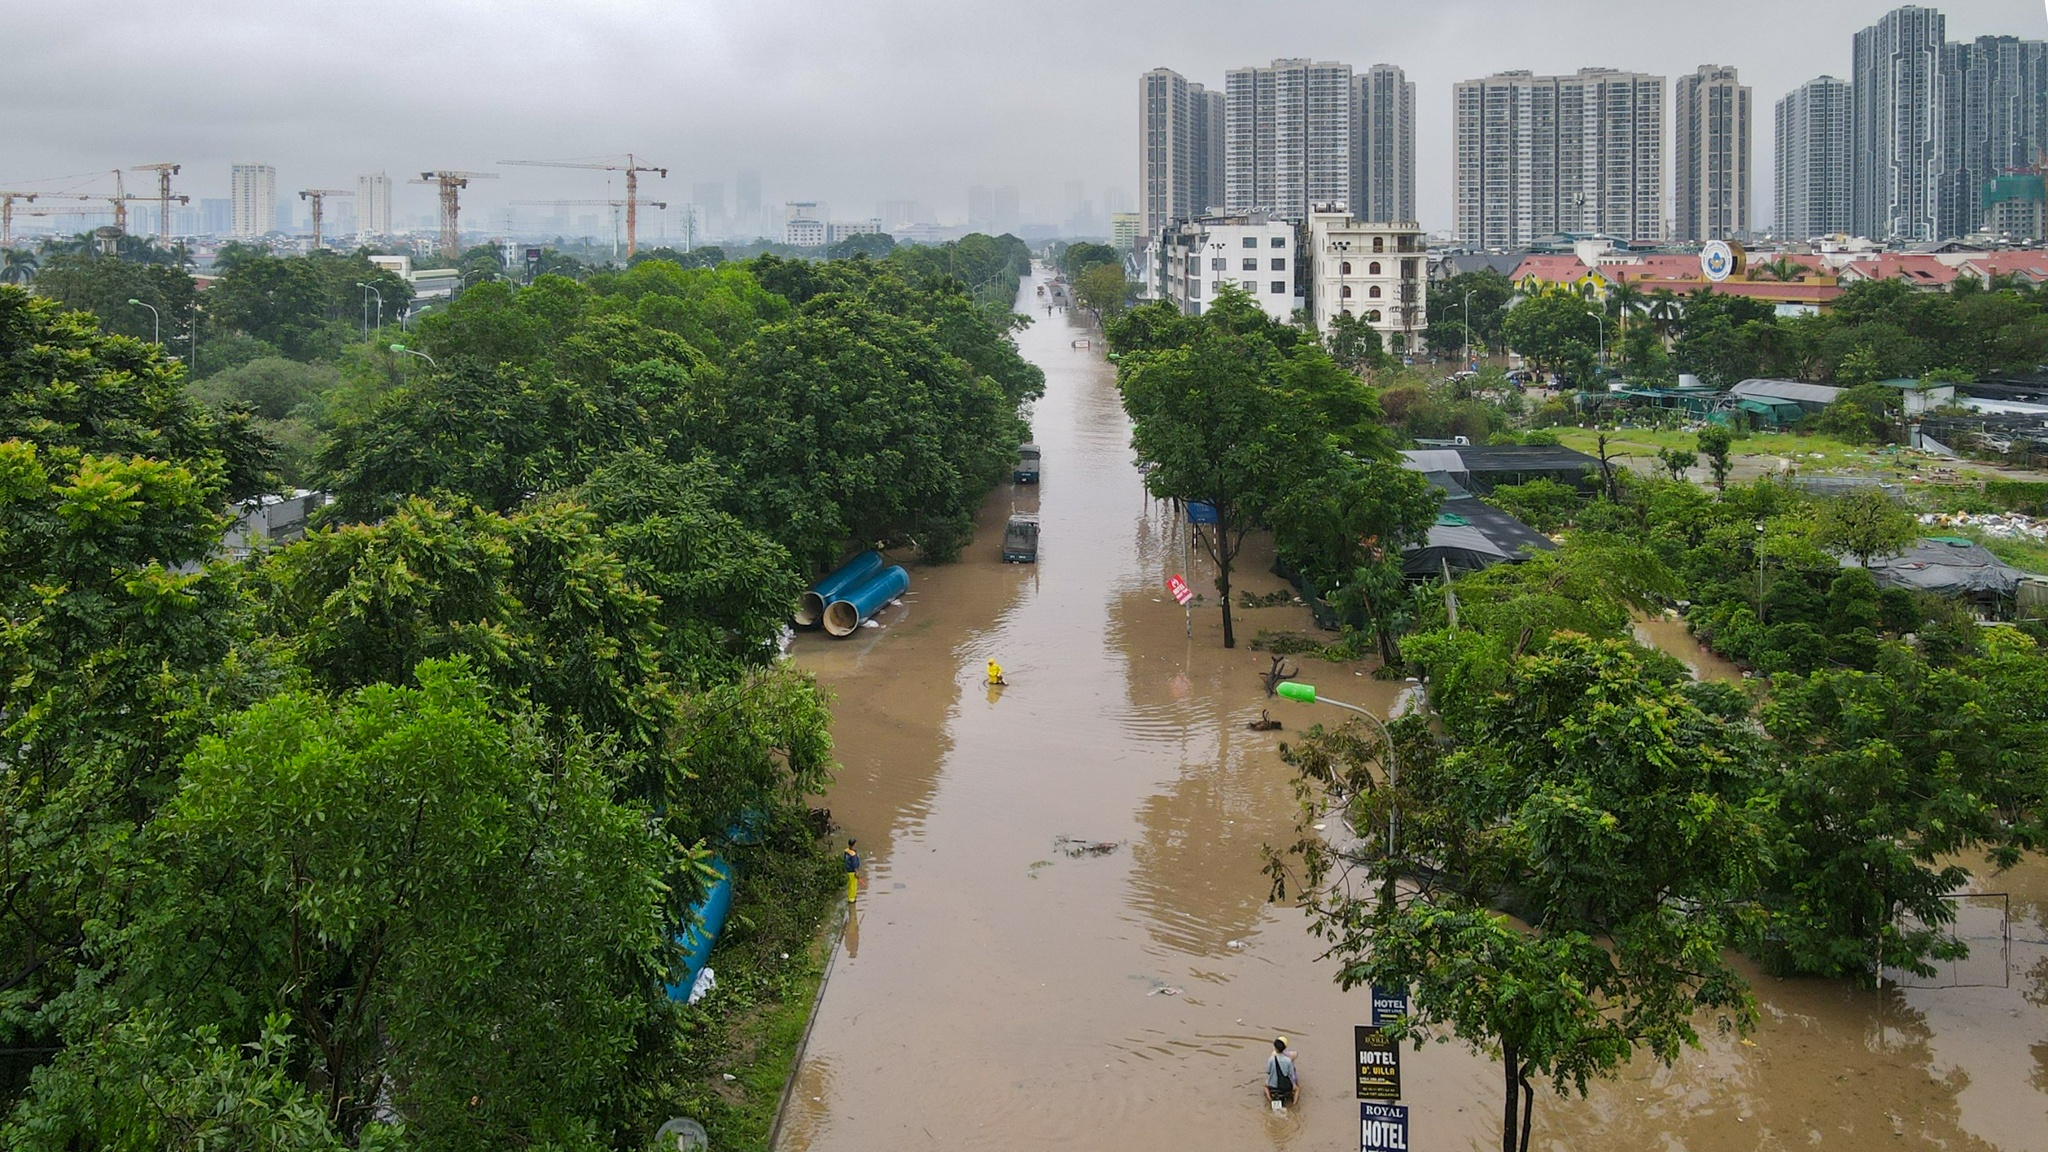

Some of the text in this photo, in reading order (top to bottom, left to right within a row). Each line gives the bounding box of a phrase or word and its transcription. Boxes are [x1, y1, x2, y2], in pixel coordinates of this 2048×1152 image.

[1374, 999, 1405, 1009] HOTEL
[1359, 1051, 1396, 1065] HOTEL
[1372, 1066, 1395, 1075] VILLA
[1366, 1105, 1403, 1118] ROYAL
[1362, 1119, 1406, 1150] HOTEL
